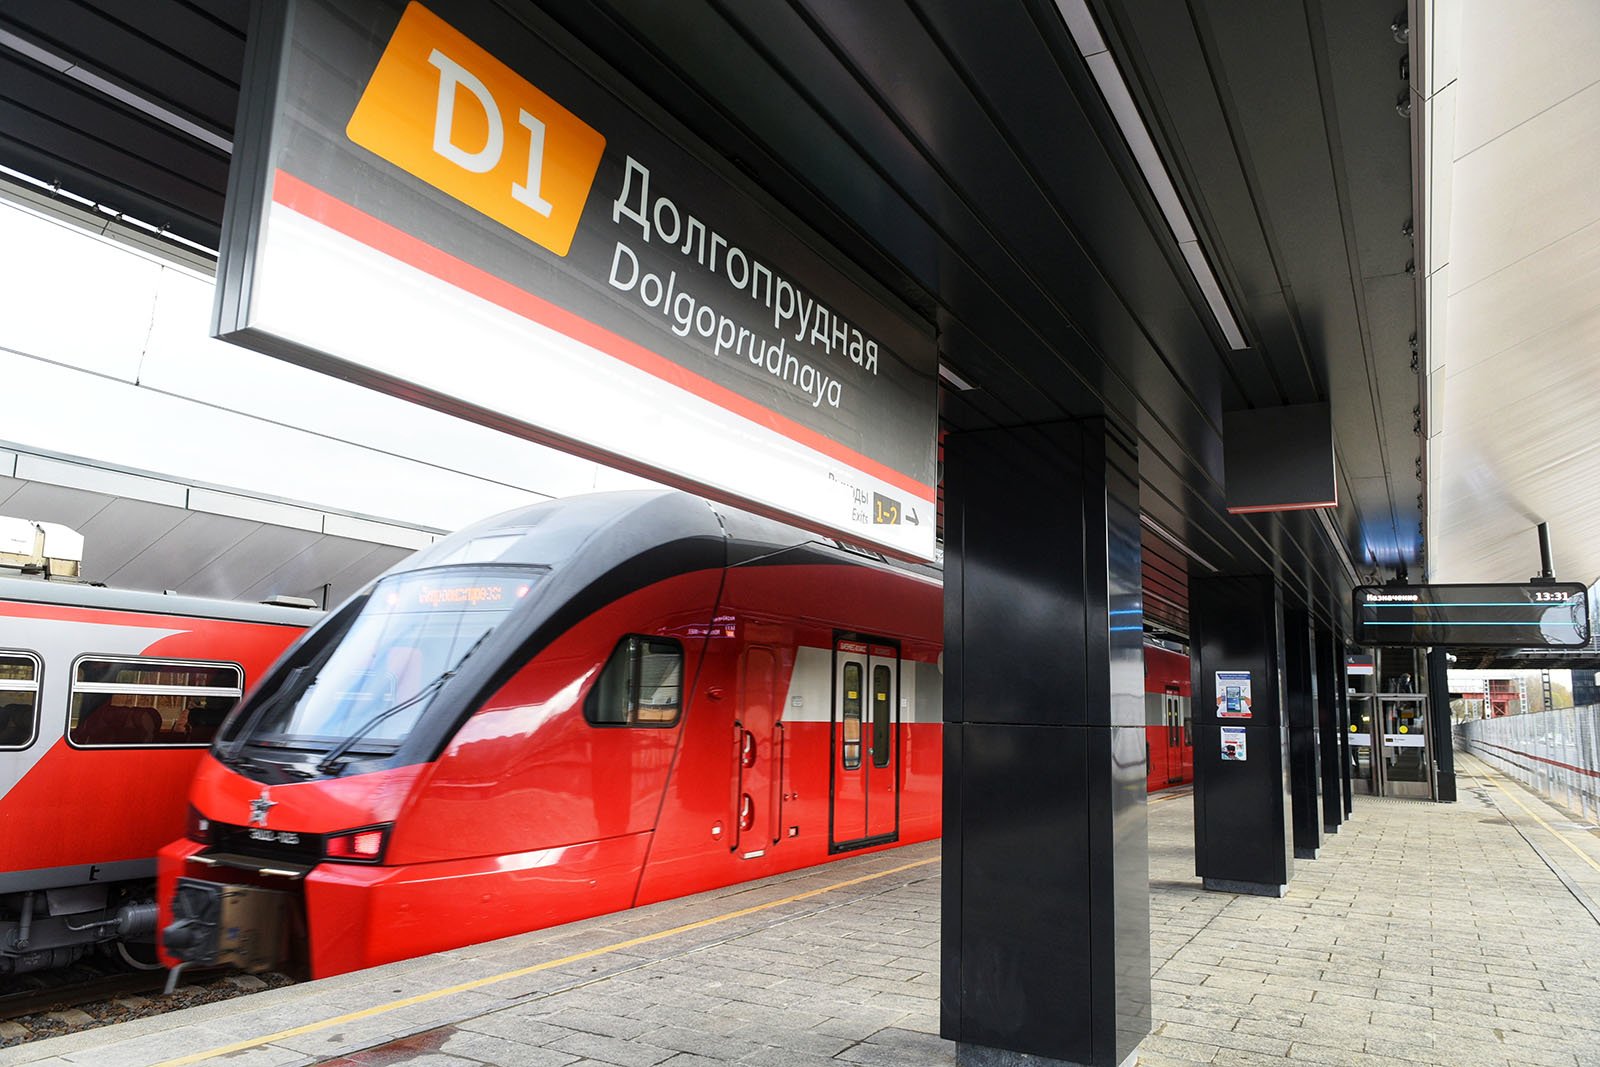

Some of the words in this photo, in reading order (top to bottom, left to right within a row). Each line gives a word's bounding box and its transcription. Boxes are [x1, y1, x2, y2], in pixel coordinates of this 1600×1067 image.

[427, 48, 553, 219] D1
[608, 241, 843, 409] Dolgoprudnaya
[612, 155, 878, 375] Долгопрудная
[852, 508, 869, 524] Exits
[1534, 592, 1569, 601] 13:31
